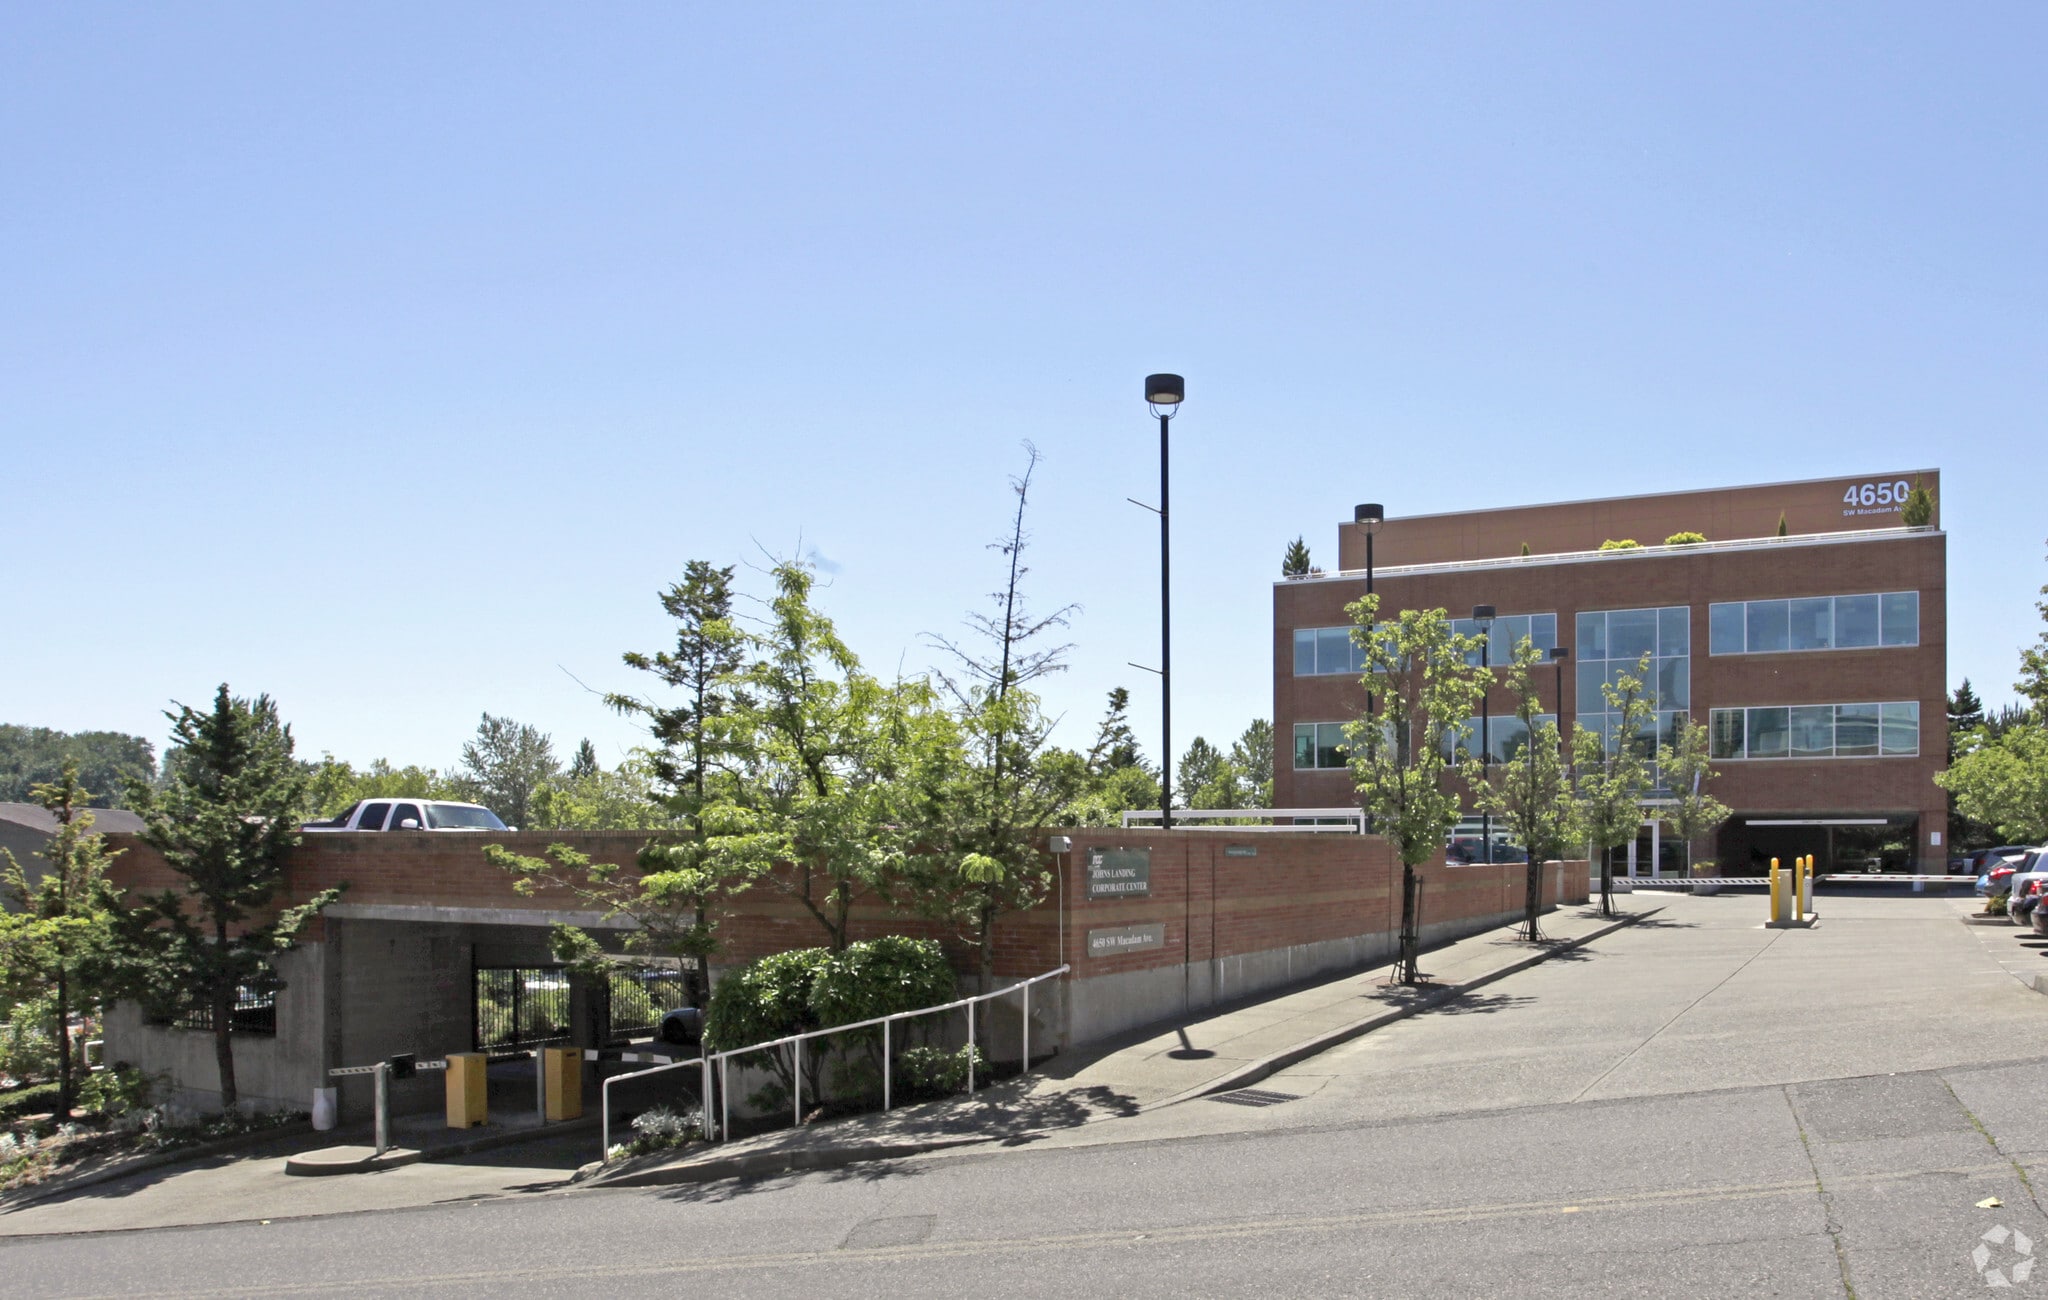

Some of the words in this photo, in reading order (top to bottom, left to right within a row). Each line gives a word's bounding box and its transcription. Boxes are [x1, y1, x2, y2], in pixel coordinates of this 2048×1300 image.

[1843, 480, 1909, 506] 4650
[1857, 507, 1892, 515] Macadam
[1092, 869, 1110, 879] JOHNS
[1112, 869, 1136, 878] LANDING
[1092, 883, 1125, 893] CORPORATE
[1126, 882, 1147, 891] CENTER
[1107, 936, 1116, 947] SW
[1117, 934, 1142, 945] Macadam
